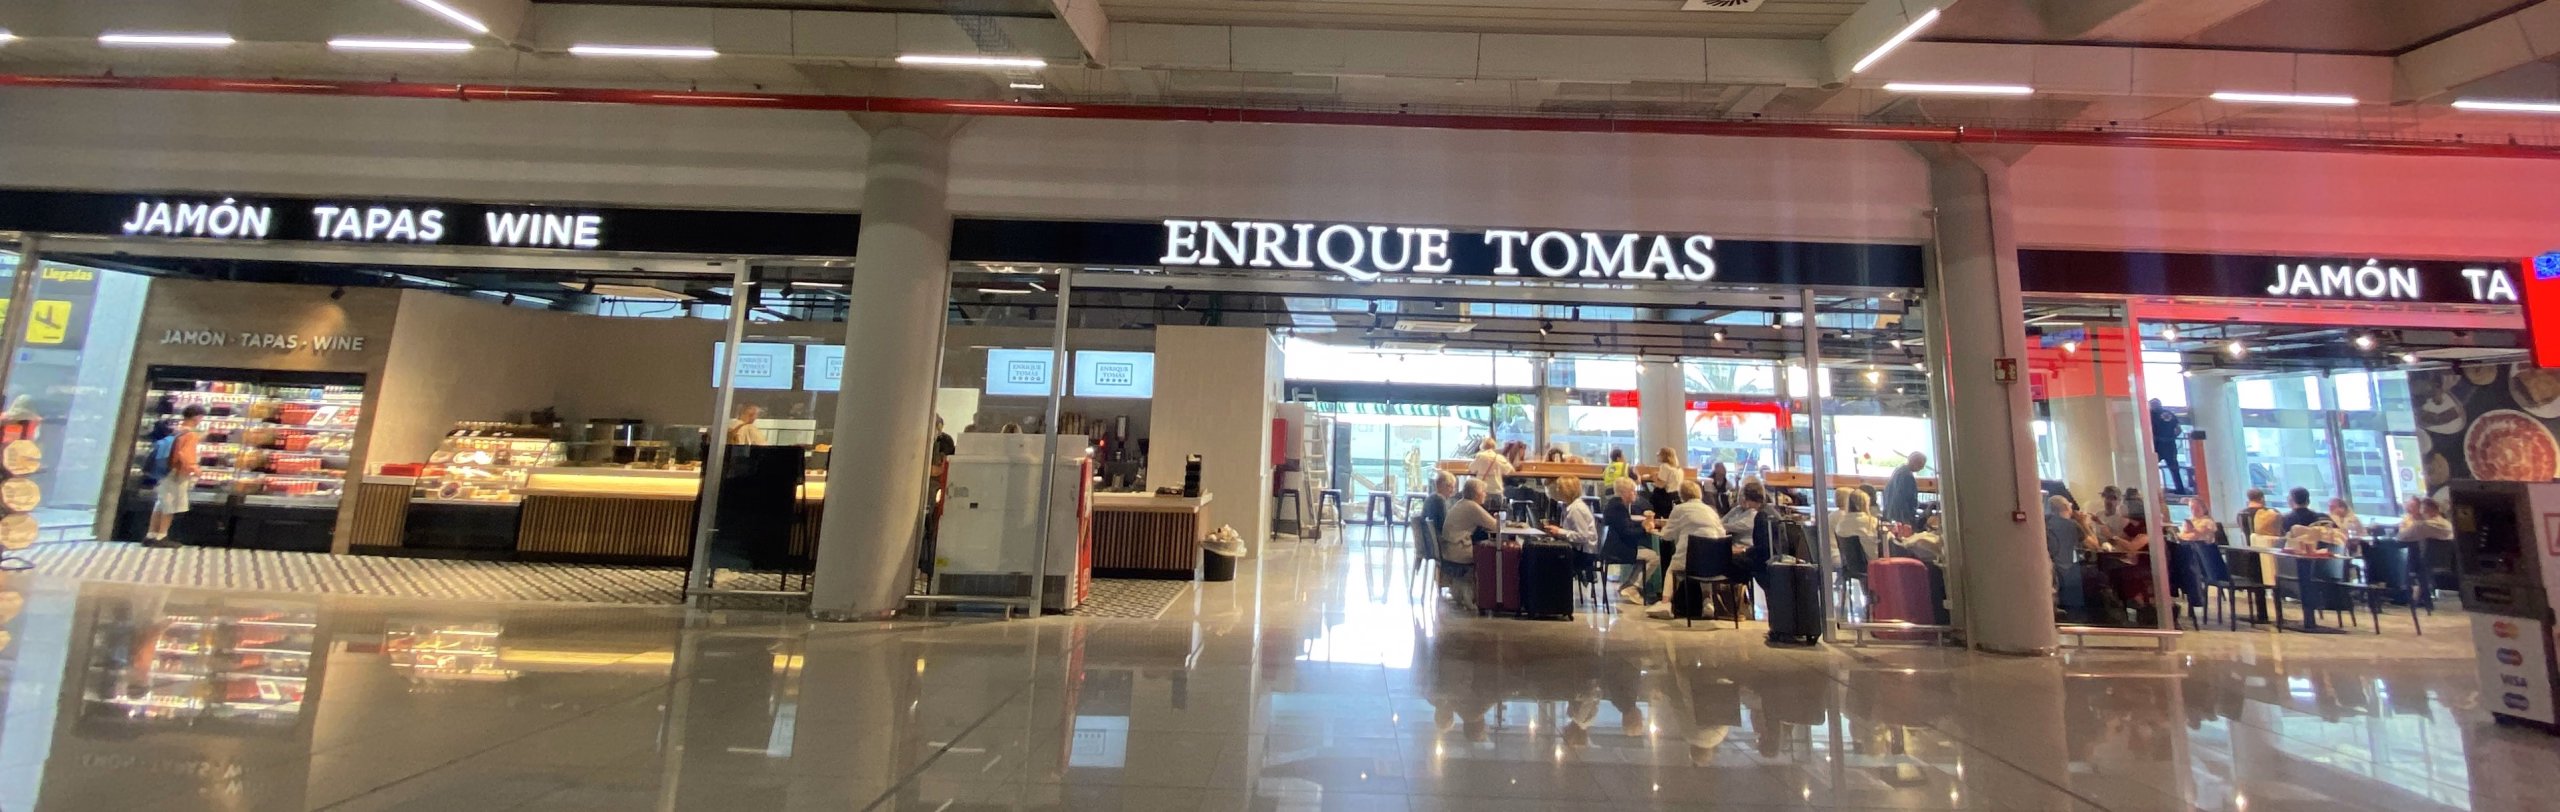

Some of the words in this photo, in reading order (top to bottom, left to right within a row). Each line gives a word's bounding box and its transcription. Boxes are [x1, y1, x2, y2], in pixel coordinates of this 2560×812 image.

[122, 198, 271, 237] JAMÓN
[313, 206, 444, 240] TAPAS
[486, 212, 602, 246] WINE
[1159, 220, 1453, 281] ENRIQUE
[1484, 229, 1715, 281] TOMAS
[42, 267, 93, 282] Llegadas
[2267, 258, 2418, 298] JAMÓN
[160, 328, 225, 346] JAMÓN
[241, 332, 298, 349] TAPAS
[314, 335, 364, 351] WINE
